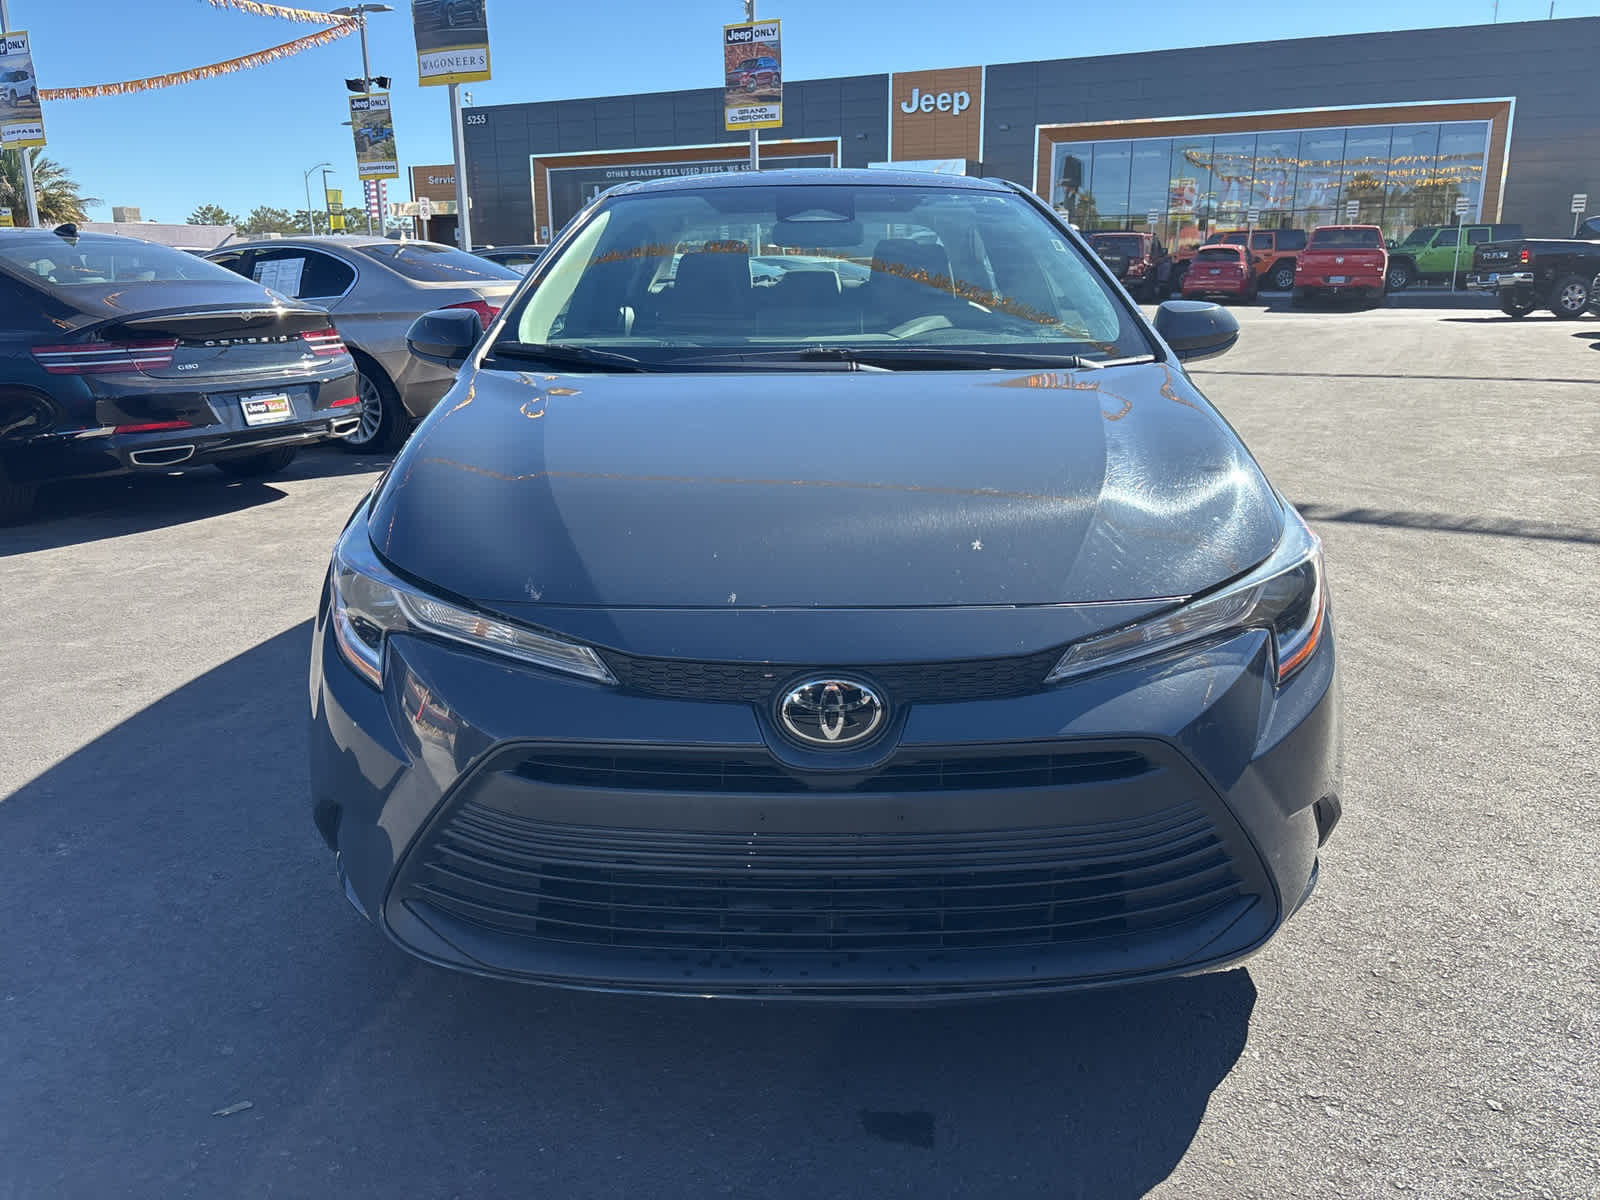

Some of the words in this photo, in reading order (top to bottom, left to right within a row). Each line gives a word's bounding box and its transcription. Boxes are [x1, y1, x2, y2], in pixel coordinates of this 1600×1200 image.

[727, 29, 752, 41] Jeep
[754, 28, 777, 38] ONLY
[7, 39, 26, 49] ONLY
[421, 56, 477, 71] WAGONEER
[351, 99, 369, 109] Jeep
[370, 99, 387, 108] ONLY
[900, 87, 971, 116] Jeep
[737, 107, 768, 115] GRAND
[467, 114, 486, 125] 5255
[730, 113, 776, 122] CHEROKEE
[606, 170, 629, 178] OTHER
[630, 168, 662, 177] DEALERS
[662, 167, 679, 176] SELL
[680, 166, 700, 176] USED
[204, 335, 288, 347] GENESIS
[177, 362, 199, 371] G80
